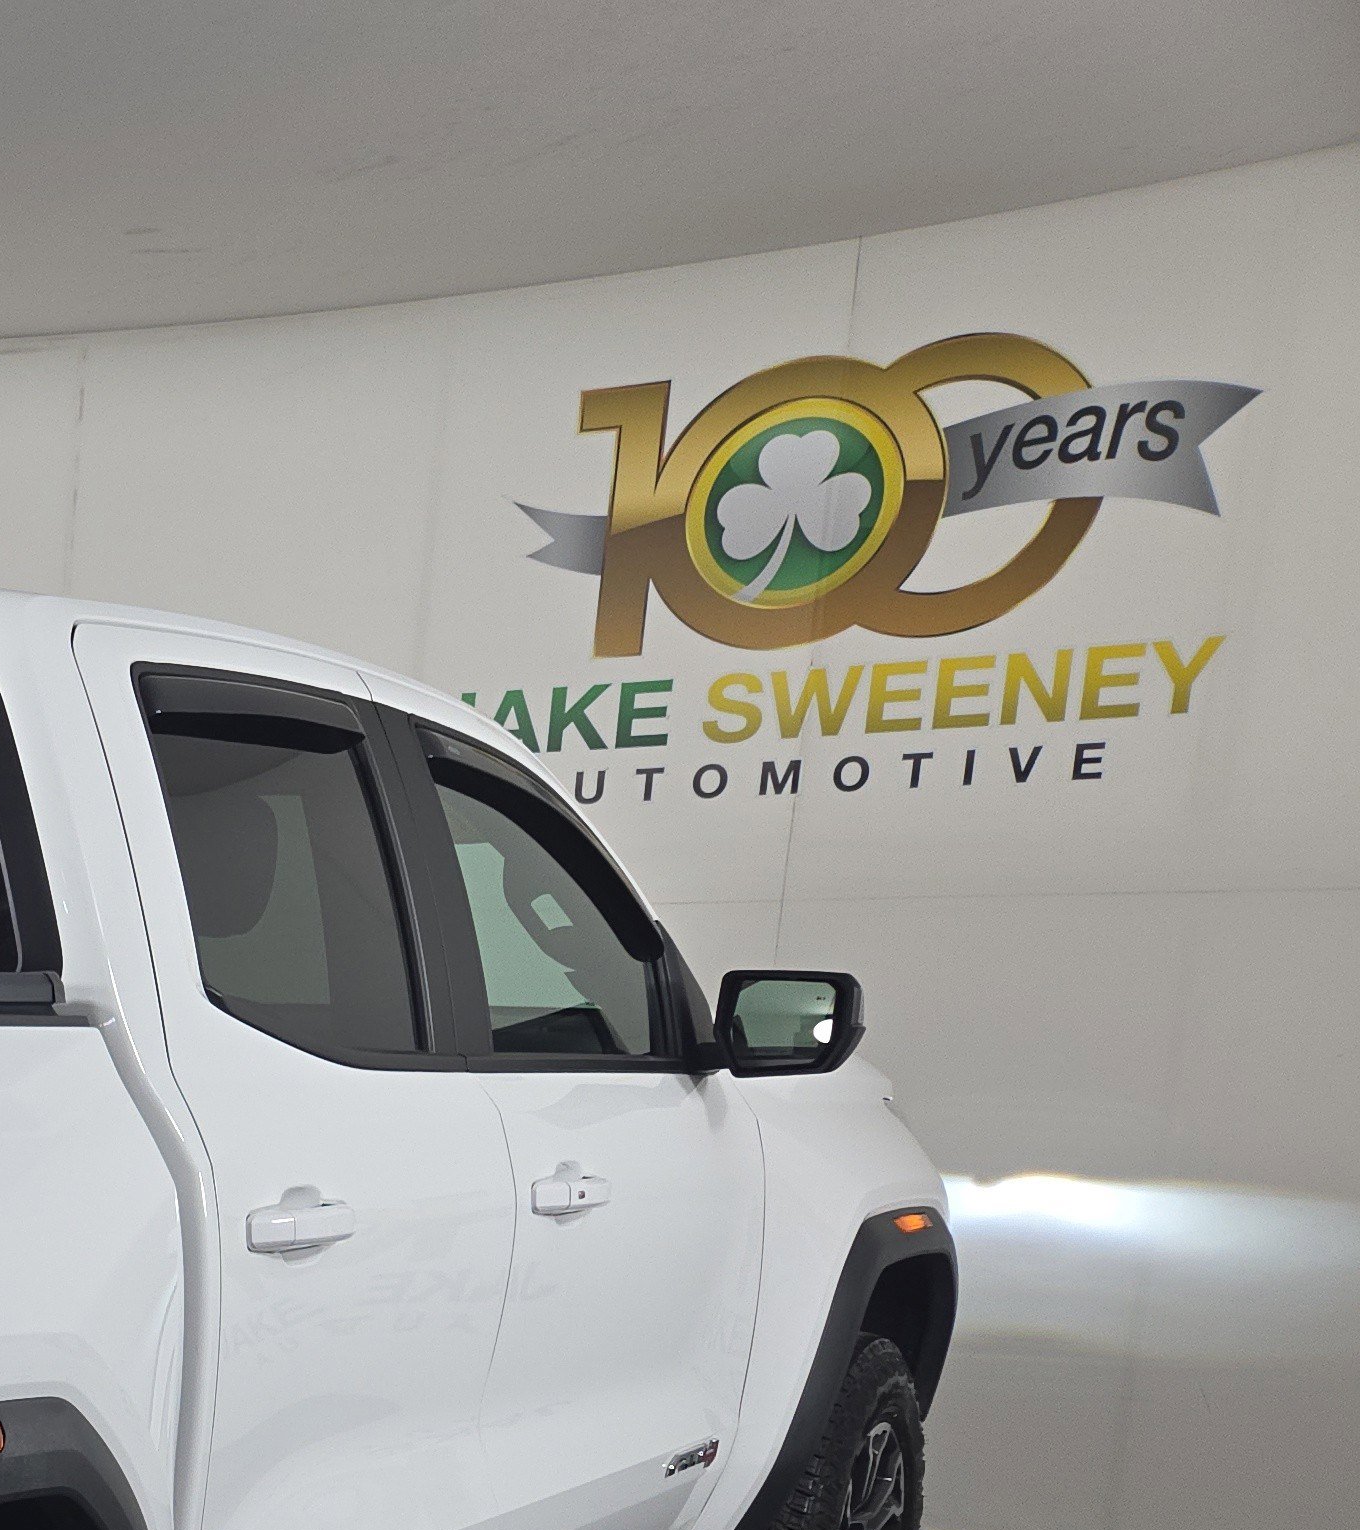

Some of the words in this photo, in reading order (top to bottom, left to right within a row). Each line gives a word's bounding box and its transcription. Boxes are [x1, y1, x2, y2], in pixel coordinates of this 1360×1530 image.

[578, 332, 1105, 658] 100
[961, 399, 1186, 501] years
[461, 677, 674, 754] AKE
[702, 635, 1226, 744] SWEENEY
[574, 741, 1107, 805] UTOMOTIVE
